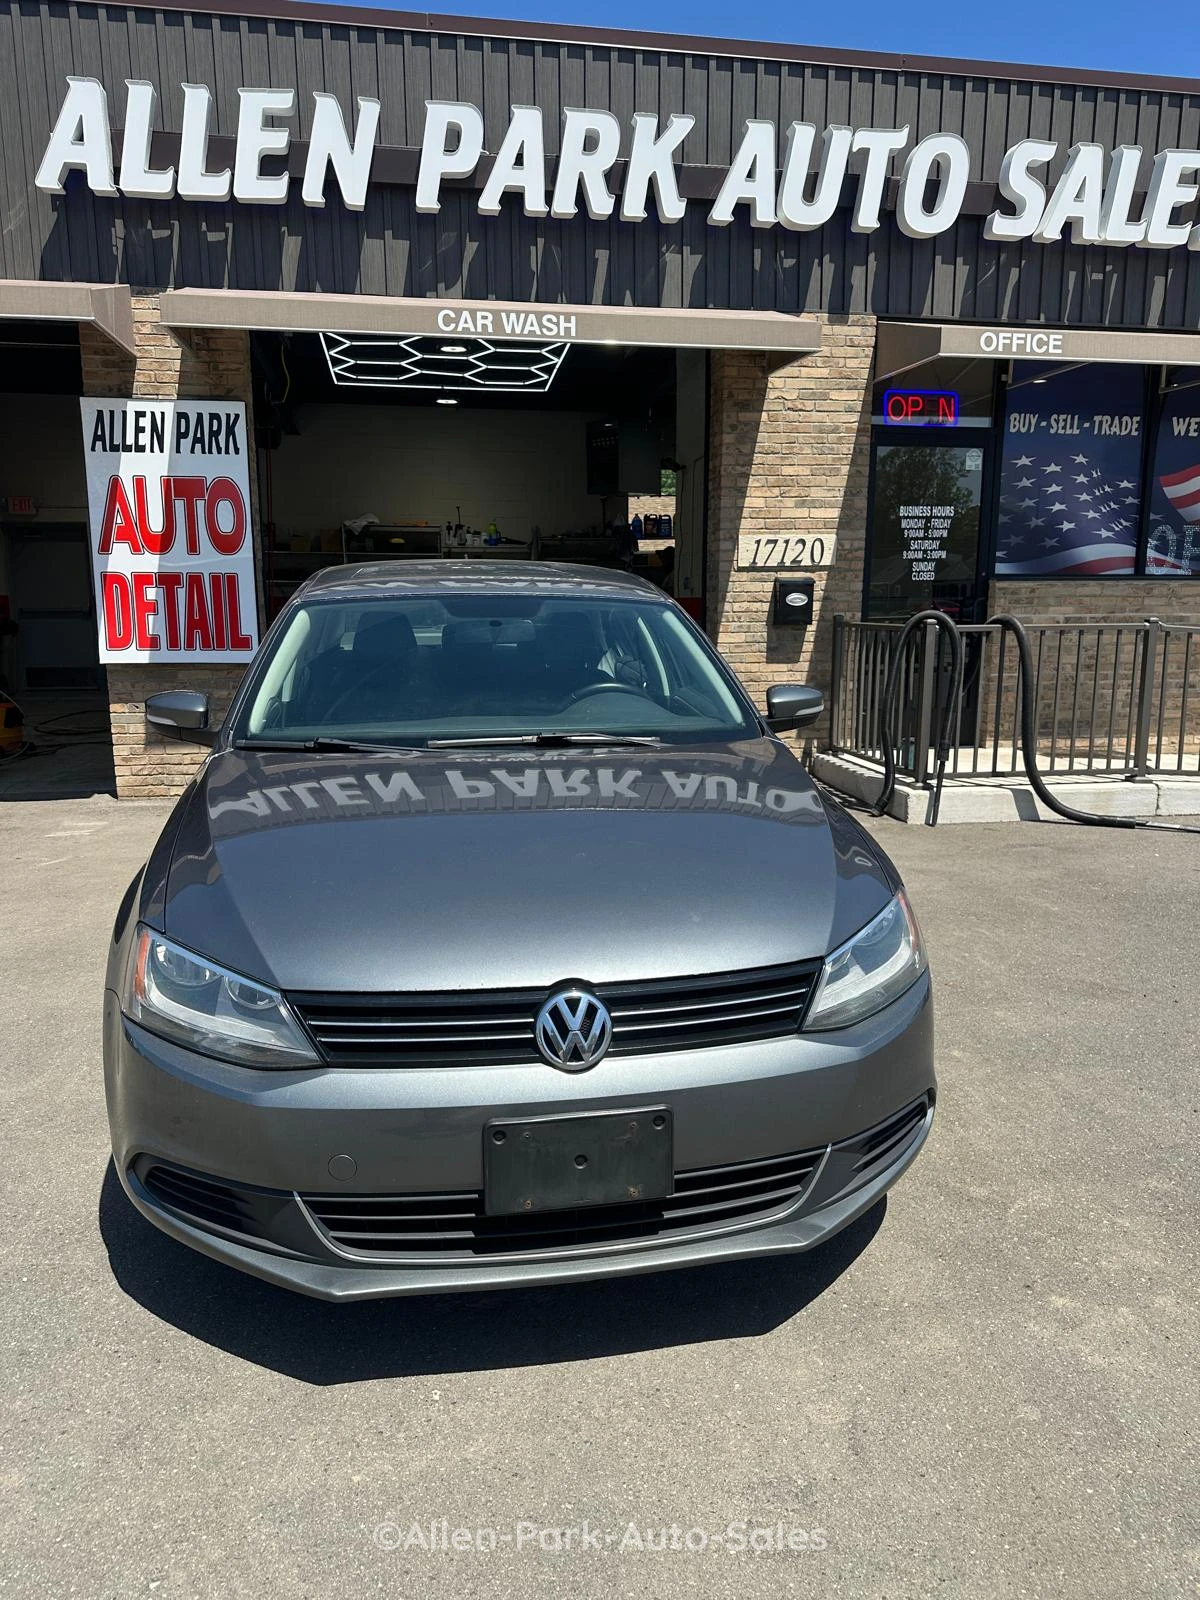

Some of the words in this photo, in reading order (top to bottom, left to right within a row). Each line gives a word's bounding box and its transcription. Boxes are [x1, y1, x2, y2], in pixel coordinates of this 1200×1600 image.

[35, 75, 381, 211] ALLEN
[415, 99, 696, 223] PARK
[707, 118, 971, 239] AUTO
[983, 138, 1200, 251] SALE
[437, 309, 494, 333] CAR
[500, 312, 577, 337] WASH
[979, 331, 1063, 354] OFFICE
[888, 396, 955, 422] OPN
[91, 409, 166, 454] ALLEN
[175, 411, 241, 455] PARK
[1009, 413, 1039, 433] BUY
[1049, 414, 1081, 434] SELL
[1093, 415, 1141, 436] TRADE
[98, 475, 247, 555] AUTO
[899, 506, 931, 517] BUSINESS
[932, 506, 954, 517] HOURS
[901, 518, 926, 528] MONDAY
[931, 518, 952, 528] FRIDAY
[903, 529, 924, 537] 9:00AM
[928, 529, 948, 537] 5:00PM
[749, 537, 825, 566] 17120
[902, 550, 923, 559] 9:00AM
[927, 550, 947, 559] 3:00PM
[910, 540, 941, 550] SATURDAY
[911, 572, 935, 580] CLOSED
[912, 561, 936, 571] SUNDAY
[100, 572, 253, 651] DETAIL
